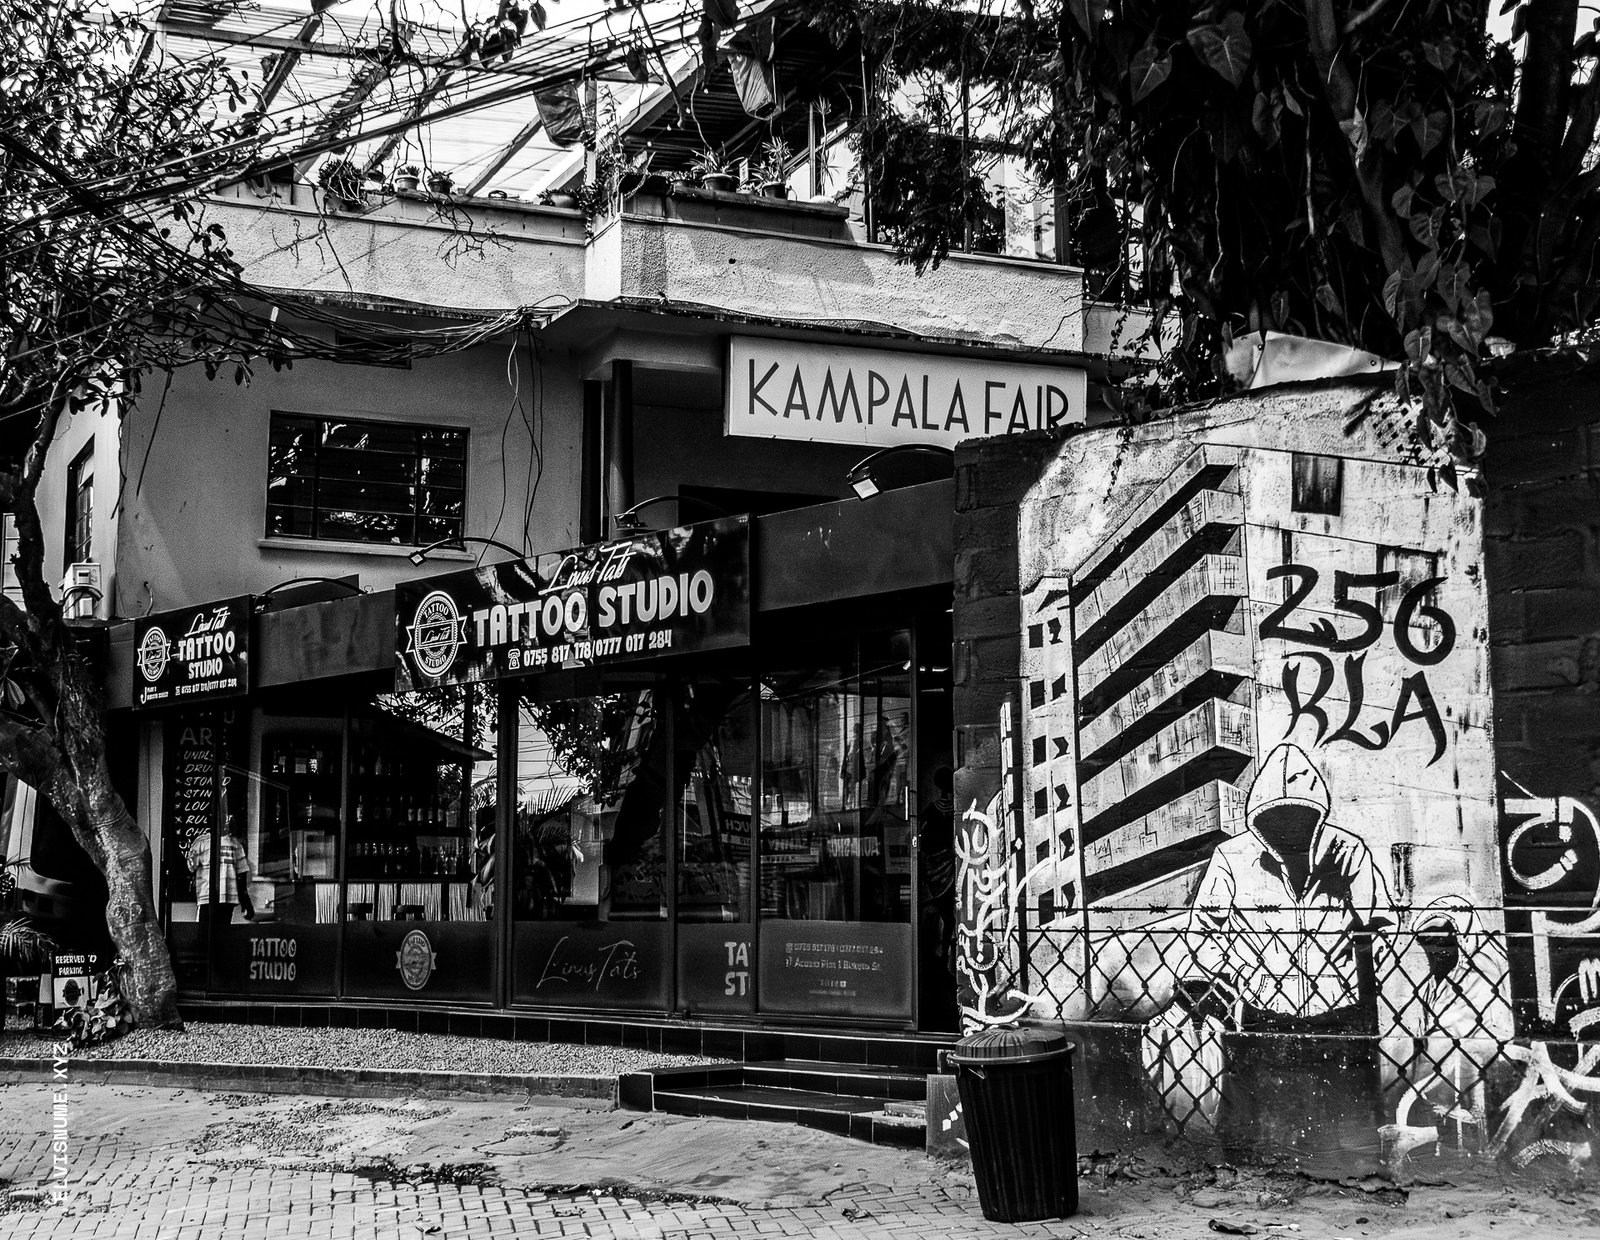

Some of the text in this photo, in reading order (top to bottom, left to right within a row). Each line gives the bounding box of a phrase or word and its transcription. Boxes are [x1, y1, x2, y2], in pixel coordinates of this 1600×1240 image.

[748, 358, 1069, 435] KAMPALA FAIR
[423, 602, 449, 618] TATTOO
[473, 569, 714, 648] TATTOO STUDIO
[1259, 564, 1457, 666] 256
[178, 630, 236, 662] TATTOO
[523, 629, 673, 667] 0755 817 178/0777 017 284
[188, 657, 223, 680] STUDIO
[1281, 650, 1448, 768] RLA
[180, 727, 213, 746] AR
[184, 801, 211, 812] LOU
[250, 937, 297, 958] TATTOO
[55, 955, 85, 965] RESERVED
[250, 961, 297, 982] STUDIO
